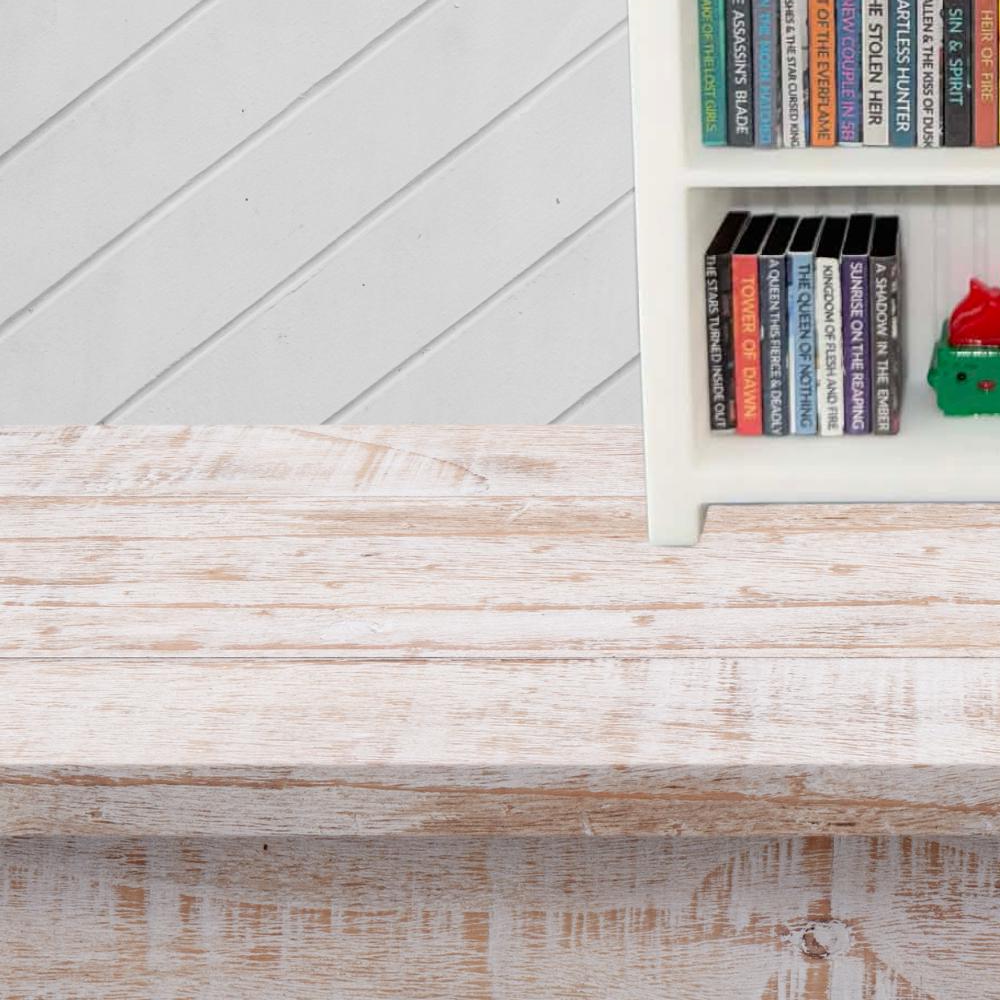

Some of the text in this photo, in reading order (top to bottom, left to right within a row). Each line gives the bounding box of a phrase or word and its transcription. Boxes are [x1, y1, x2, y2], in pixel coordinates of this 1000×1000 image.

[817, 9, 831, 29] OF
[922, 35, 933, 43] &
[733, 10, 747, 85] ASSASSIN'S
[787, 36, 797, 55] THE
[787, 56, 798, 81] STAR
[818, 31, 831, 61] THE
[841, 36, 855, 98] COUPLE
[869, 23, 883, 83] STOLEN
[922, 46, 933, 68] THE
[949, 8, 963, 106] SIN & SPIRIT
[981, 11, 993, 102] HEIR OF FIRE
[789, 83, 800, 122] CURSED
[818, 62, 831, 140] EVERFLAME
[869, 90, 883, 125] HEIR
[896, 68, 910, 131] HUNTER
[923, 71, 934, 96] KISS
[923, 99, 934, 115] OF
[735, 91, 749, 134] BLADE
[841, 102, 855, 117] IN
[841, 123, 855, 141] 5B
[923, 117, 934, 148] DUSK
[706, 255, 726, 427] THE STARS TURNED INSIDE OUT
[741, 277, 757, 417] TOWER OF DAWN
[767, 260, 782, 434] A QUEEN THIS FIERCE & DEADLY
[796, 264, 813, 428] THE QUEEN OF NOTHING
[823, 265, 839, 430] KINGDOM OF FLESH AND FIRE
[850, 262, 865, 430] SUNRISE ON THE REAPING
[875, 263, 890, 431] A SHADOW IN THE EMBER
